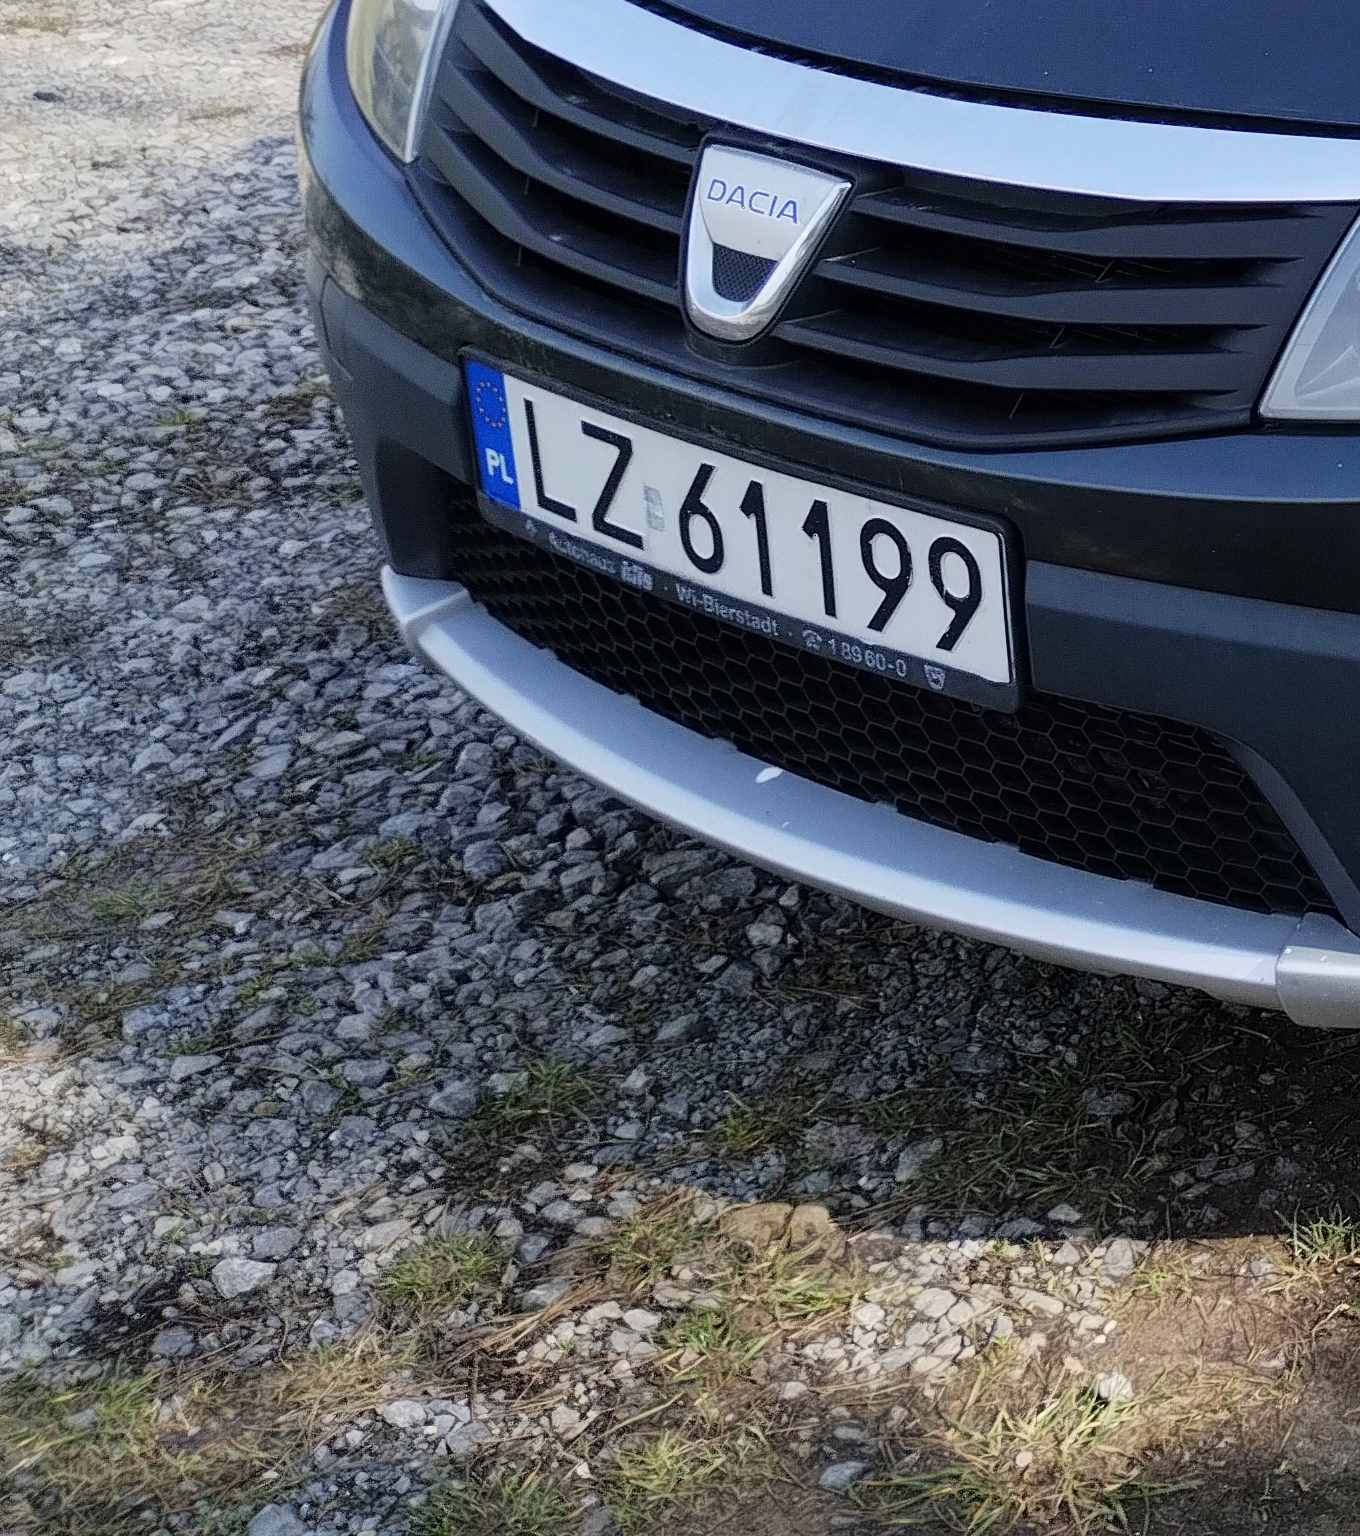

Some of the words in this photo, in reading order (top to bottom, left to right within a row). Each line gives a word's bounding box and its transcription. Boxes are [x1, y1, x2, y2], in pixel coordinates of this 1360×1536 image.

[707, 178, 798, 225] DACIA
[485, 447, 514, 485] PL
[523, 398, 645, 551] LZ
[678, 462, 983, 652] 61199
